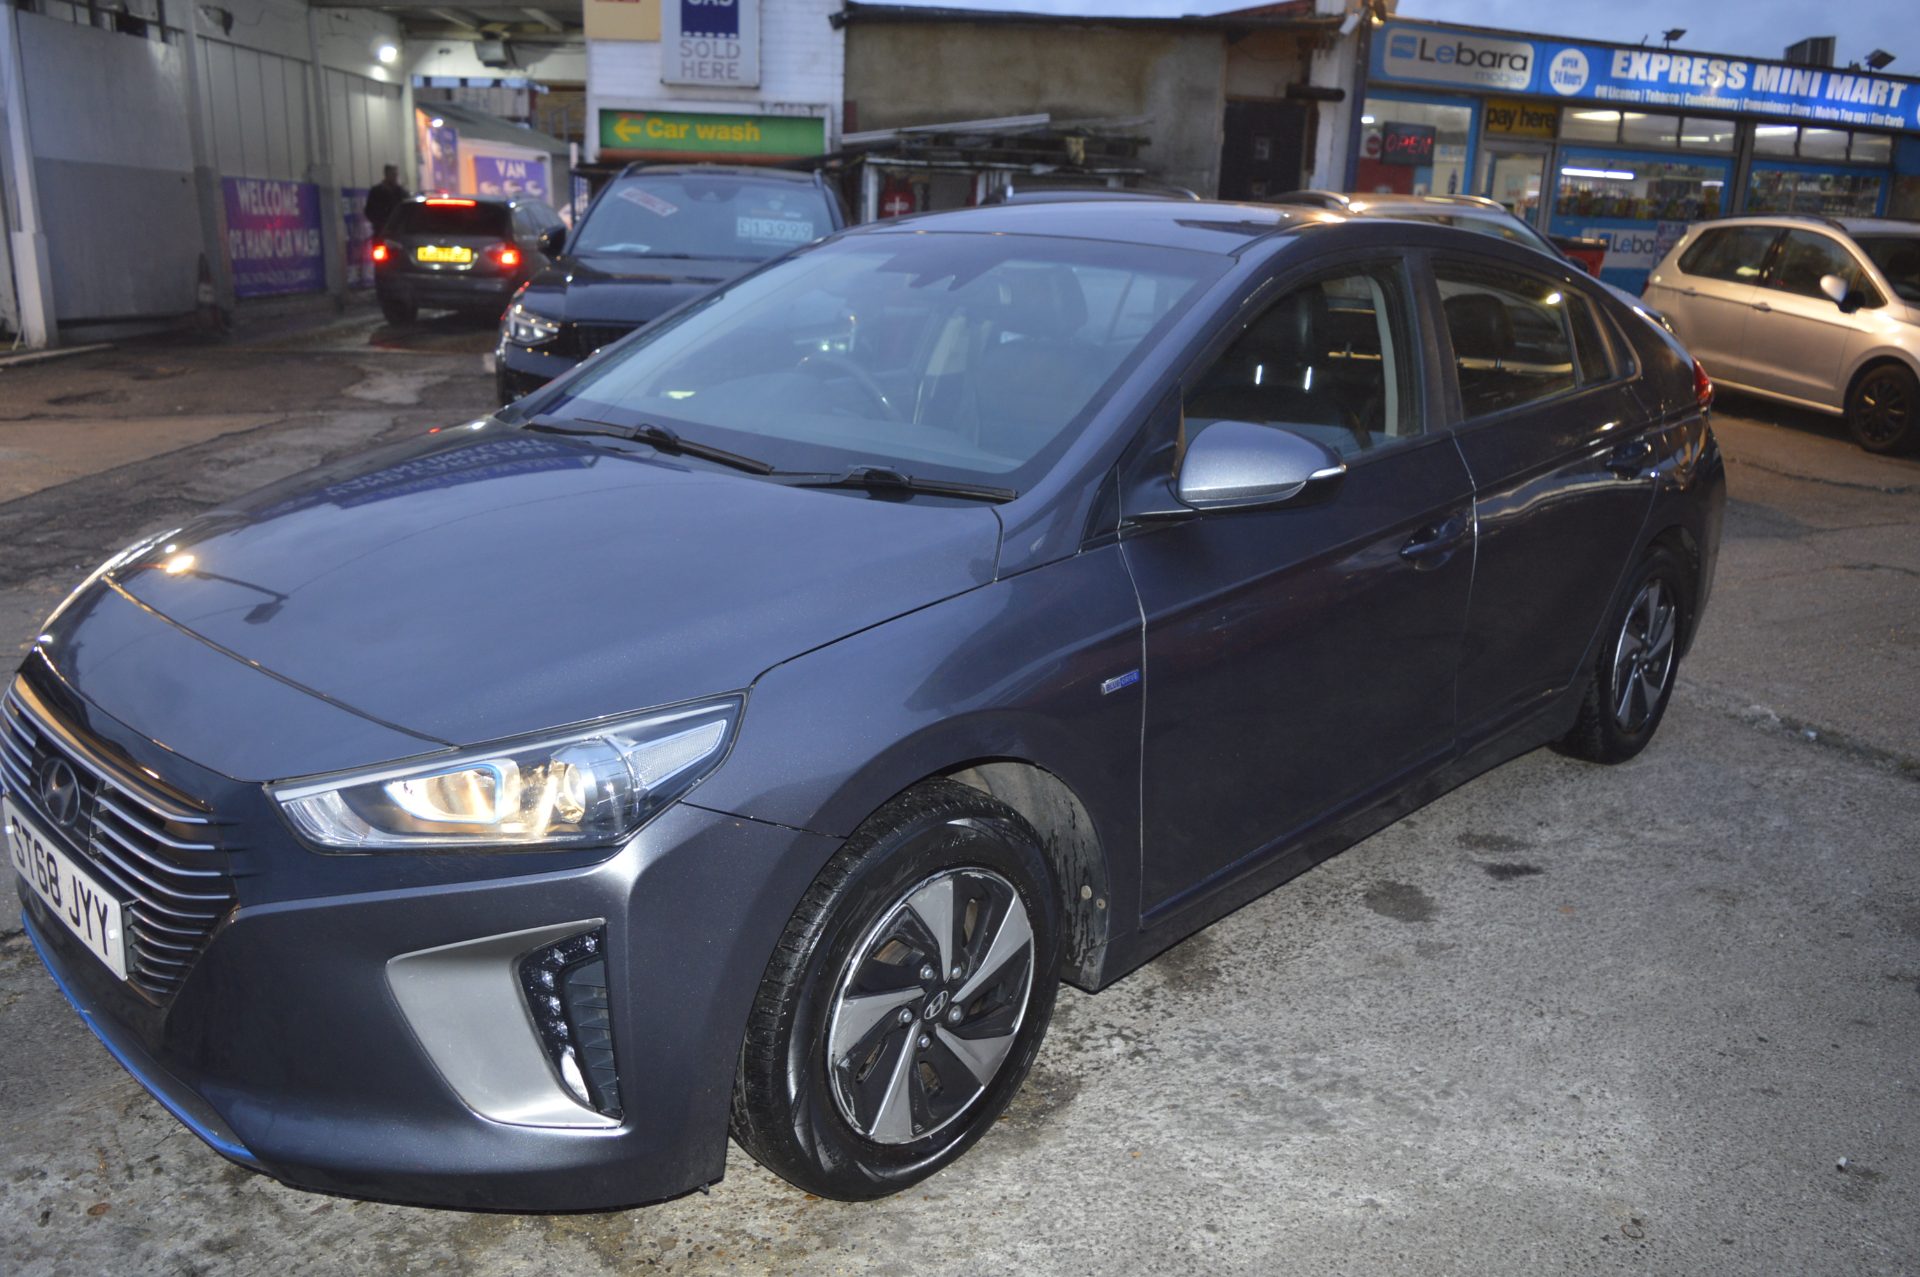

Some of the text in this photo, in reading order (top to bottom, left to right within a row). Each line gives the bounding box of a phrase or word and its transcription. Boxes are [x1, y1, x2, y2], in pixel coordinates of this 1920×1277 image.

[680, 39, 741, 60] SOLD
[1419, 37, 1529, 72] Lebara
[681, 61, 740, 80] HERE
[1475, 70, 1526, 84] mobile
[1611, 49, 1907, 108] EXPRESS MINI MART
[1487, 105, 1556, 130] pay here
[646, 118, 762, 142] Car wash
[495, 159, 527, 179] VAN
[236, 180, 300, 216] WELCOME
[1612, 233, 1655, 254] Leba
[11, 815, 109, 957] ST68 JYY
